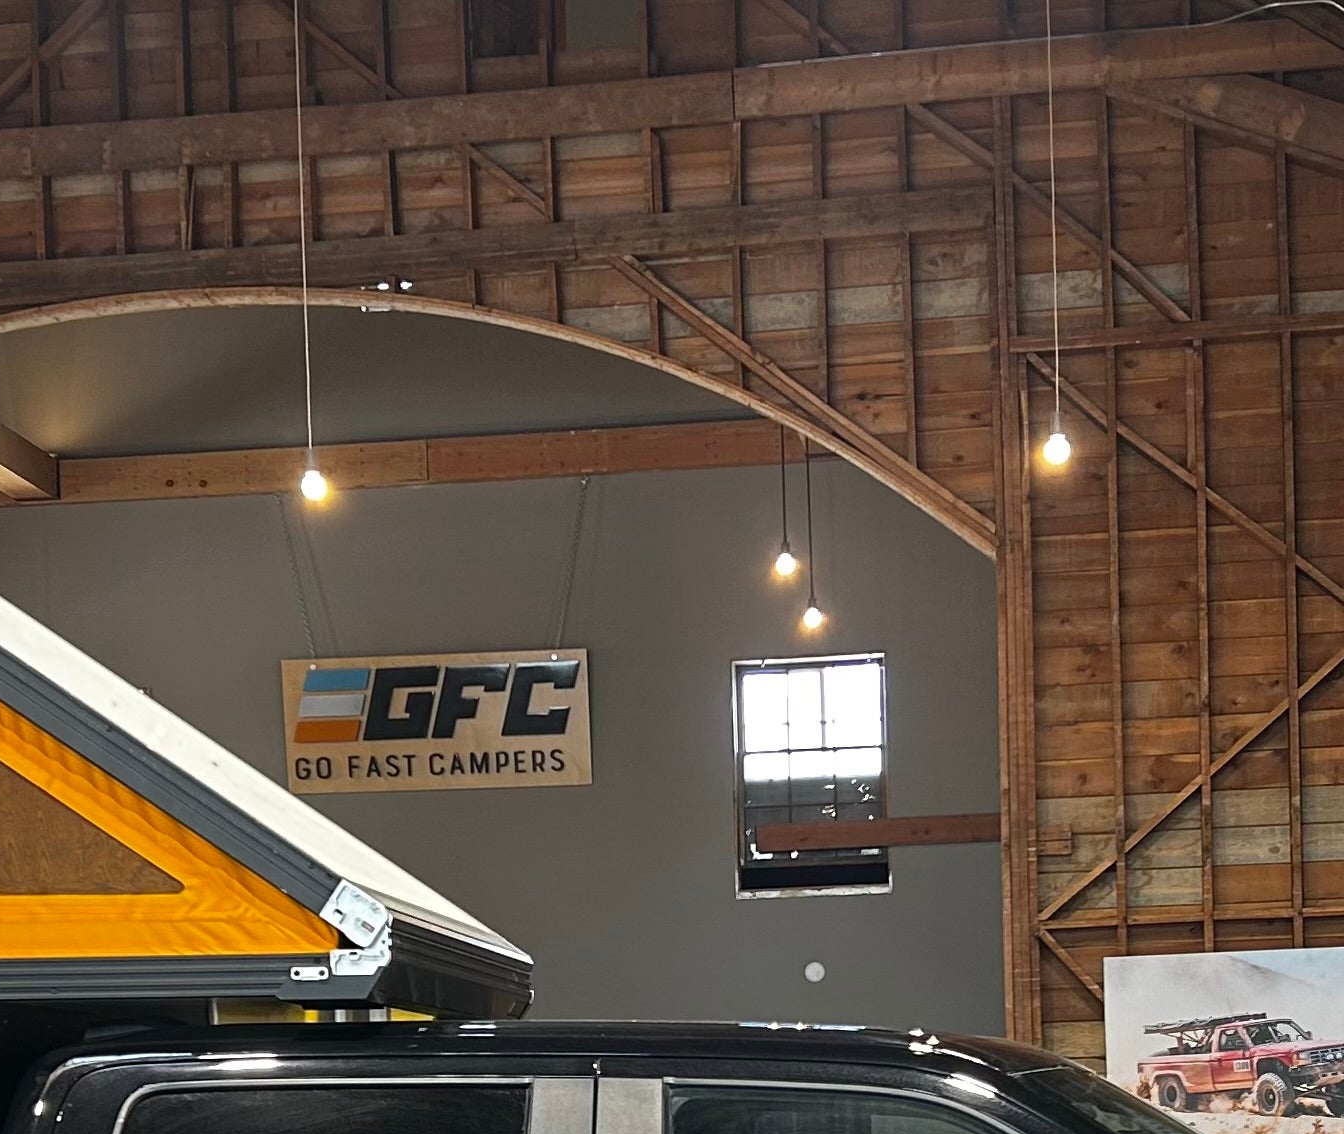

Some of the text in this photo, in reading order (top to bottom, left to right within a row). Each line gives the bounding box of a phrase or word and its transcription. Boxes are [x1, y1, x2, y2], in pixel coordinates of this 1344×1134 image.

[363, 660, 580, 741] GFC
[295, 749, 565, 780] GO FAST CAMPERS
